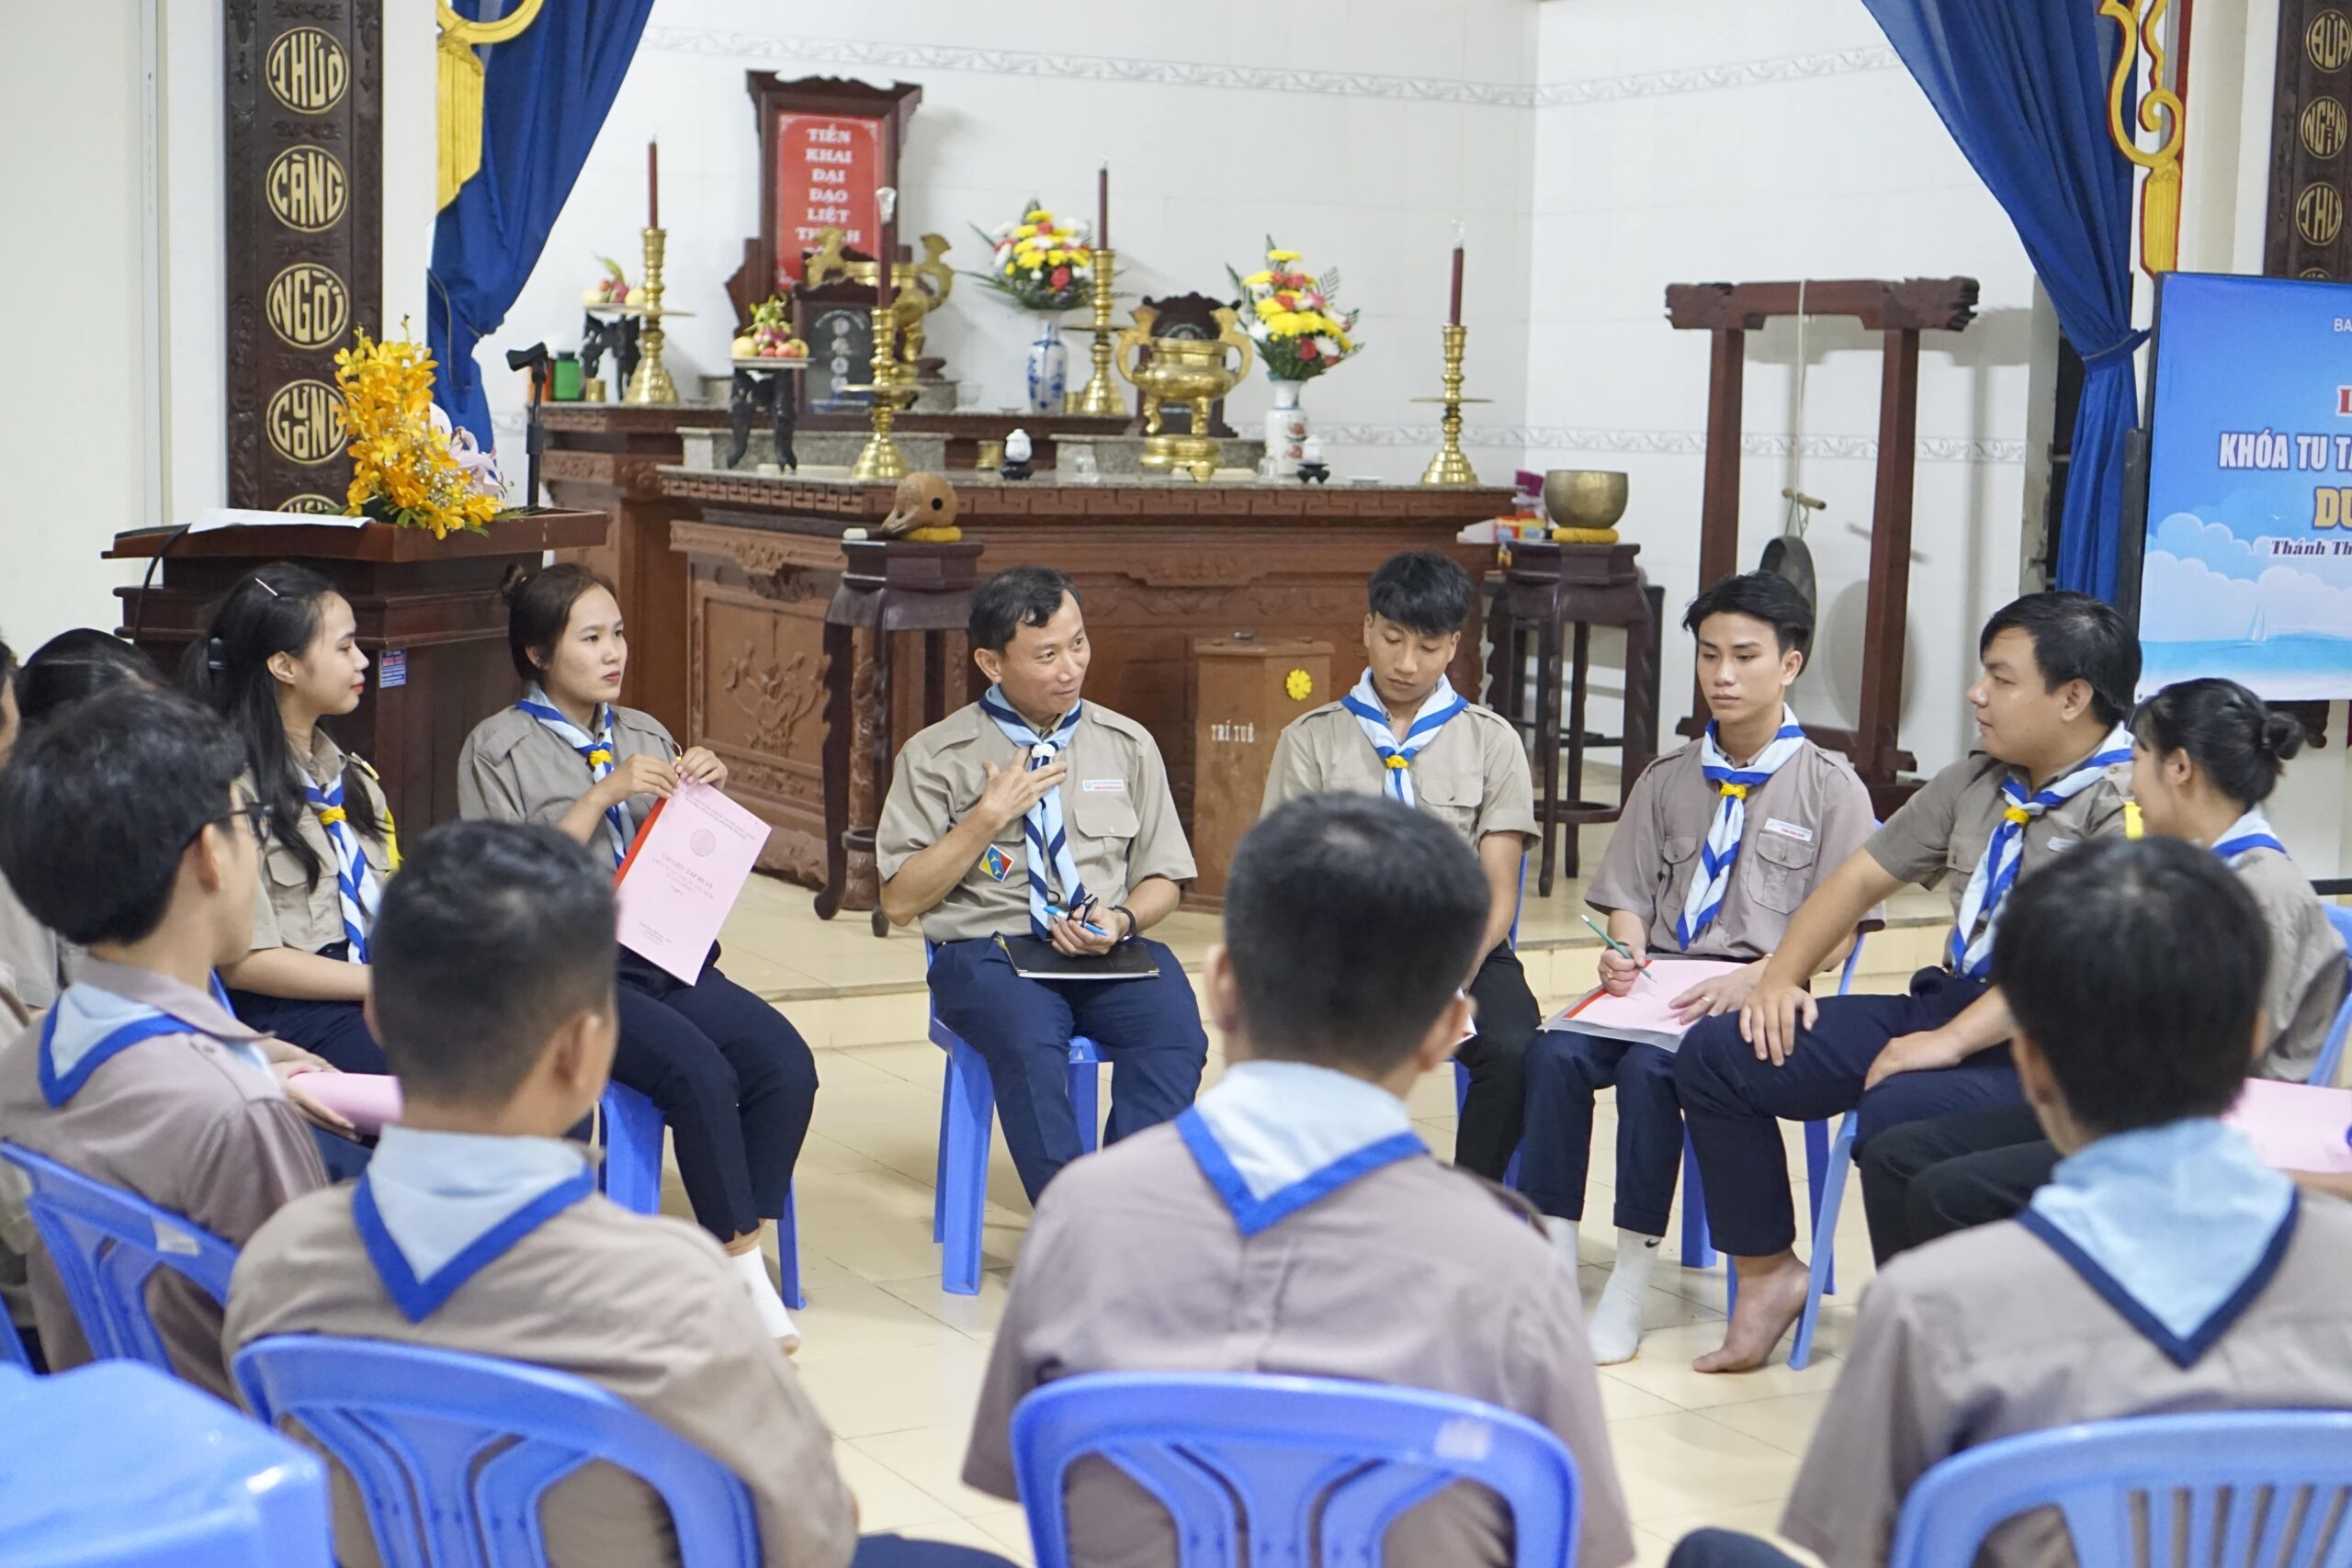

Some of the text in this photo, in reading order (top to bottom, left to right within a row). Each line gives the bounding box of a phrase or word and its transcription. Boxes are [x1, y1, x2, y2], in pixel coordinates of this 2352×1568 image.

[805, 147, 853, 164] KHAI
[272, 152, 344, 226] CÀNG
[2218, 428, 2290, 469] KHÓA
[2297, 435, 2330, 470] TU
[2271, 539, 2326, 556] Thánh
